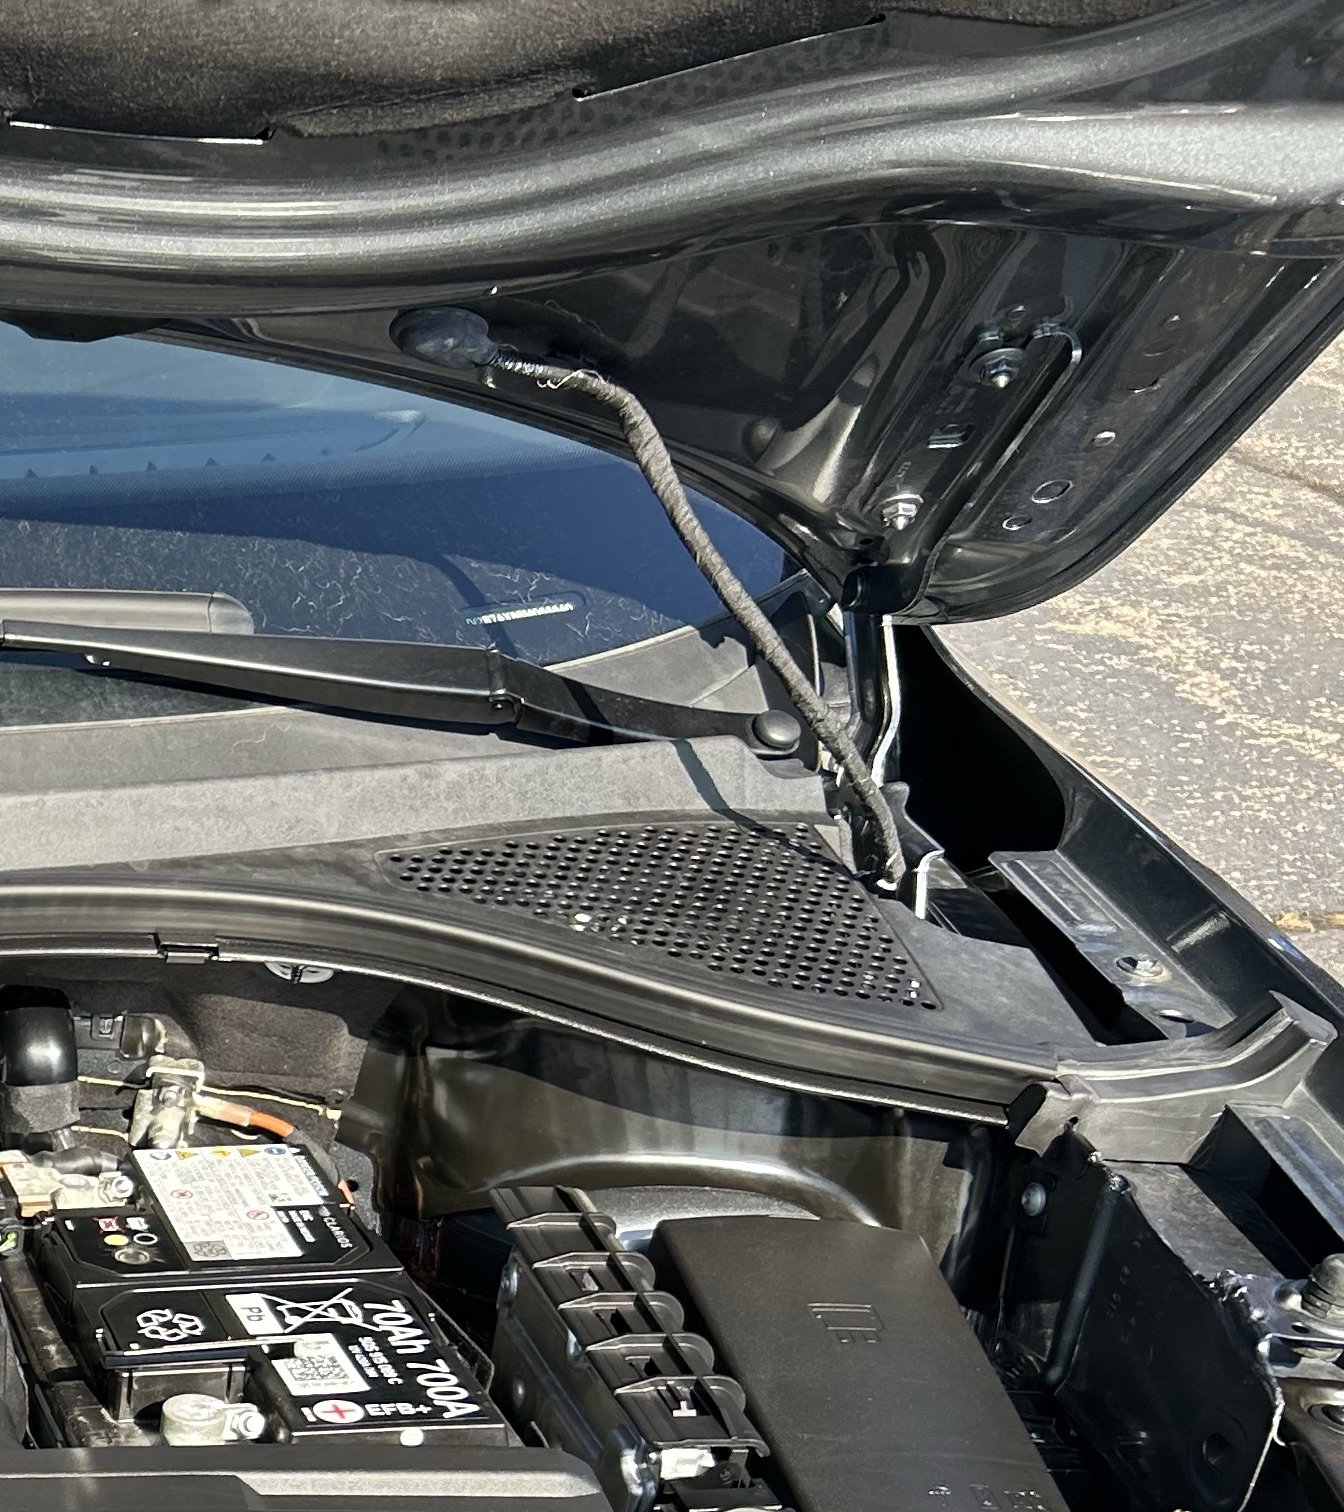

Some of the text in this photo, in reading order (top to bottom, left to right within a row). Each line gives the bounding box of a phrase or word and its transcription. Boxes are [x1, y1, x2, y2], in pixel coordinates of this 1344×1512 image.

[323, 1217, 353, 1248] CLARIOS
[241, 1306, 264, 1321] Pb
[364, 1300, 431, 1354] 70Ah
[406, 1359, 480, 1418] 700A
[365, 1402, 432, 1418] EFB+
